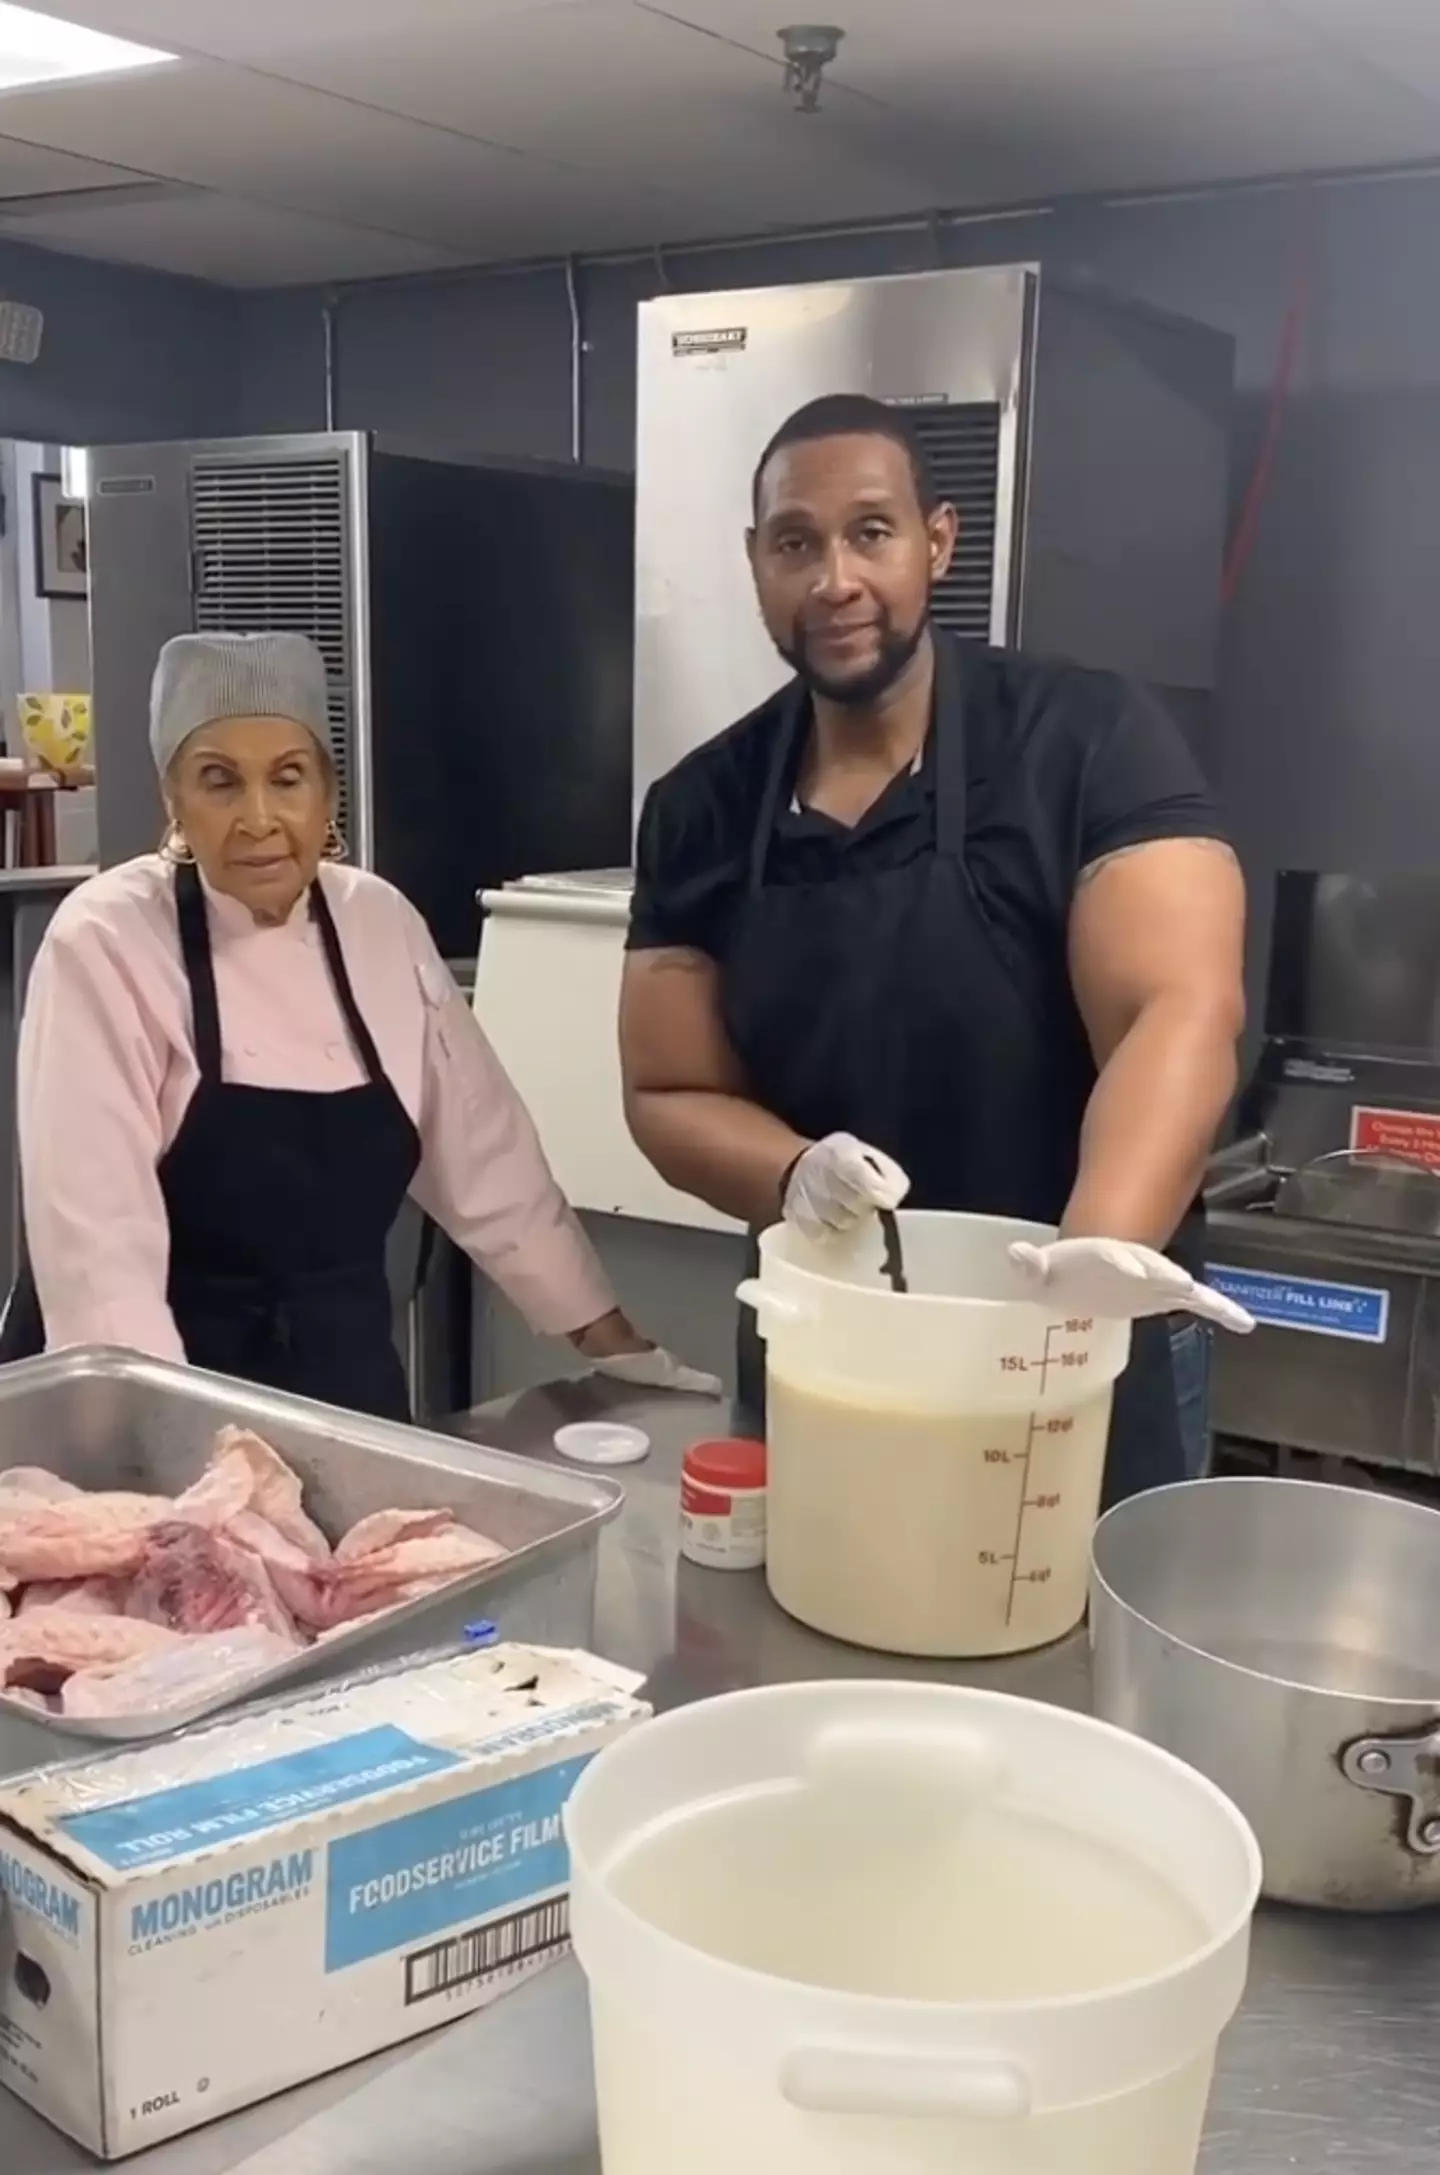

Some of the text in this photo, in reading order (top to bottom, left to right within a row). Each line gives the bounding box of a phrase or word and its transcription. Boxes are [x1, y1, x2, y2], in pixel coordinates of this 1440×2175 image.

[1286, 1292, 1316, 1307] FILL
[1318, 1297, 1353, 1314] LINE
[349, 1833, 504, 1914] FOODSERVICE
[510, 1814, 560, 1854] FILM
[130, 1849, 313, 1942] MONOGRAM
[130, 2091, 180, 2121] 1 ROLL
